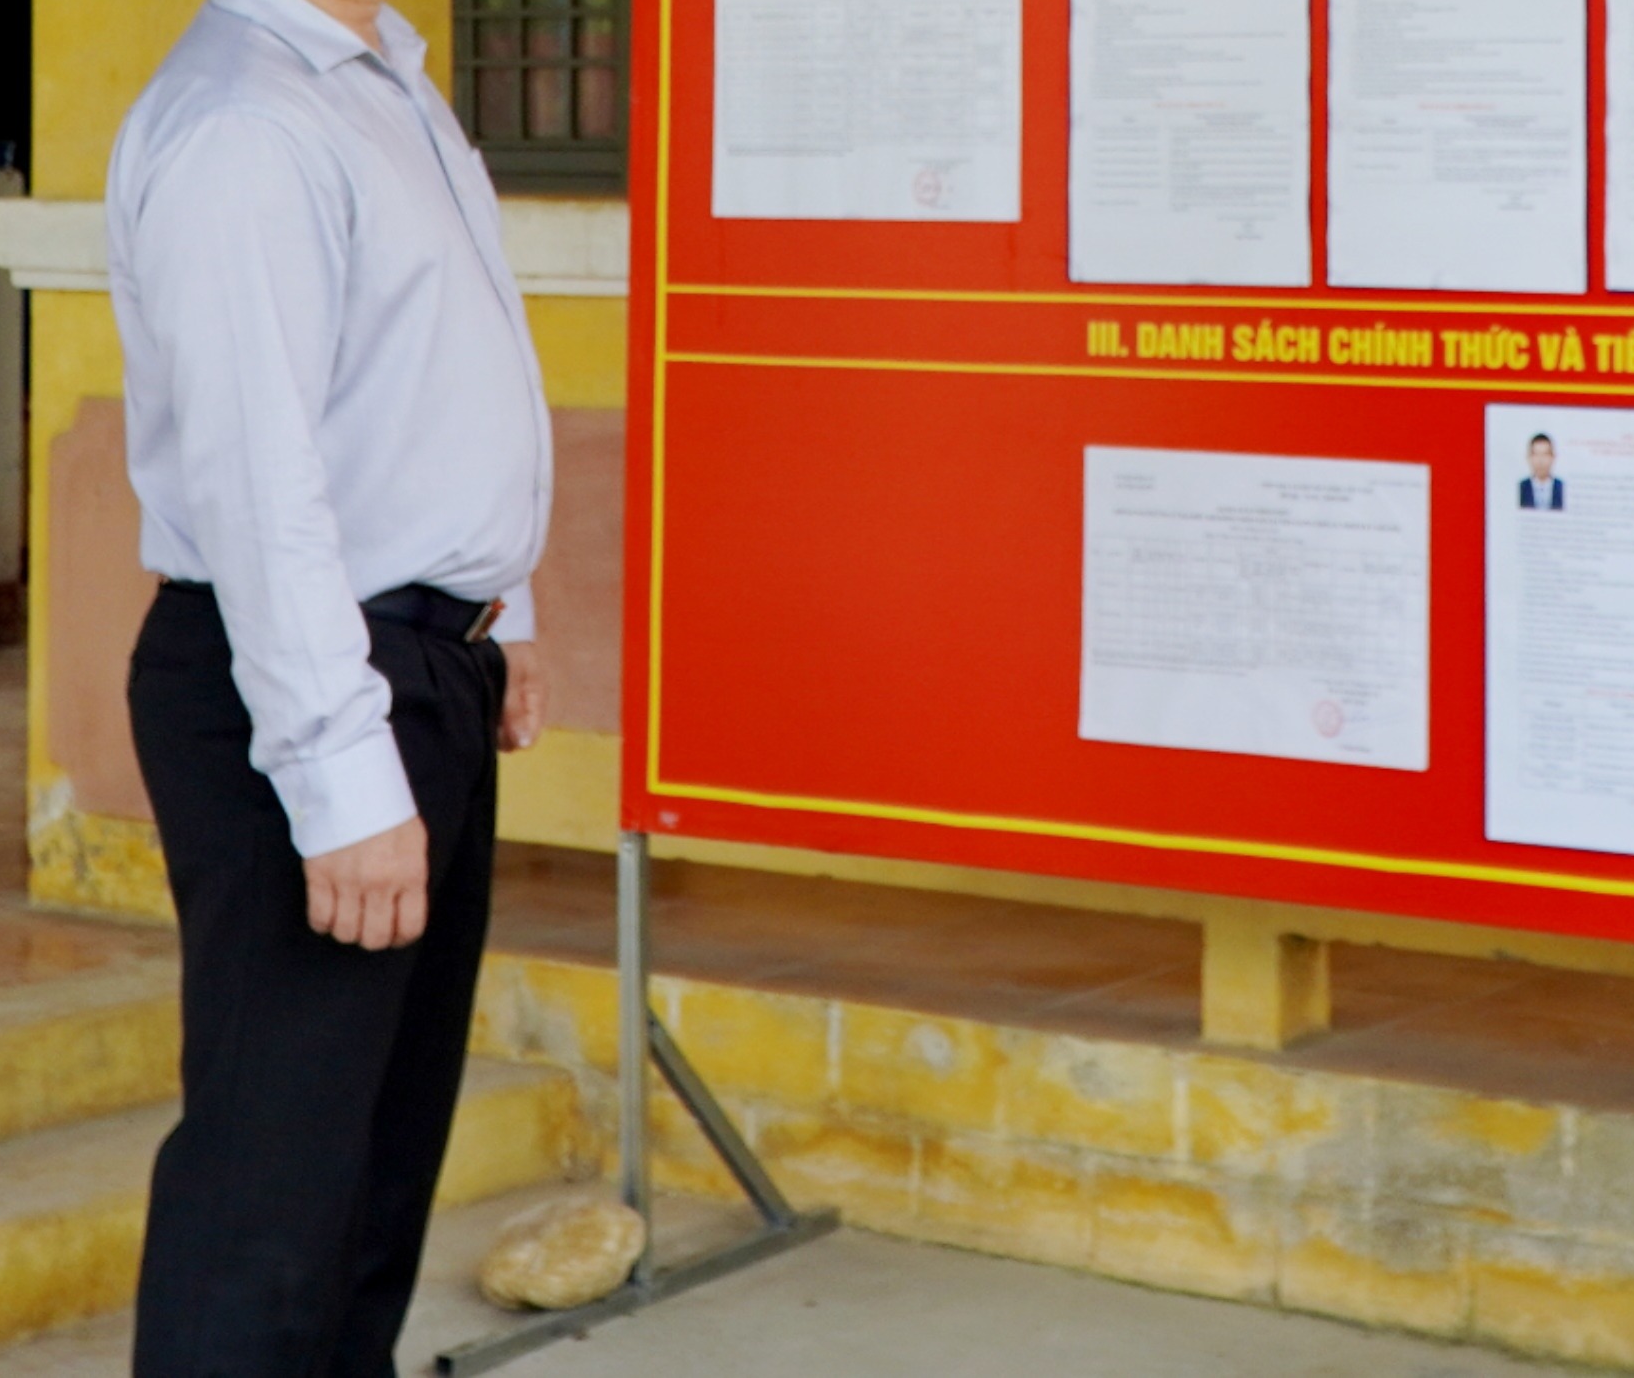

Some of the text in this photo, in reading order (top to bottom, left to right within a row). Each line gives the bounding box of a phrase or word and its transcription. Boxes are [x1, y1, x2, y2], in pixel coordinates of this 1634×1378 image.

[1087, 321, 1128, 356] III.
[1137, 323, 1224, 360] DANH
[1232, 321, 1320, 362] SÁCH
[1328, 324, 1432, 366] CHÍNH
[1441, 326, 1529, 370] THỨC
[1538, 328, 1585, 371] VÀ
